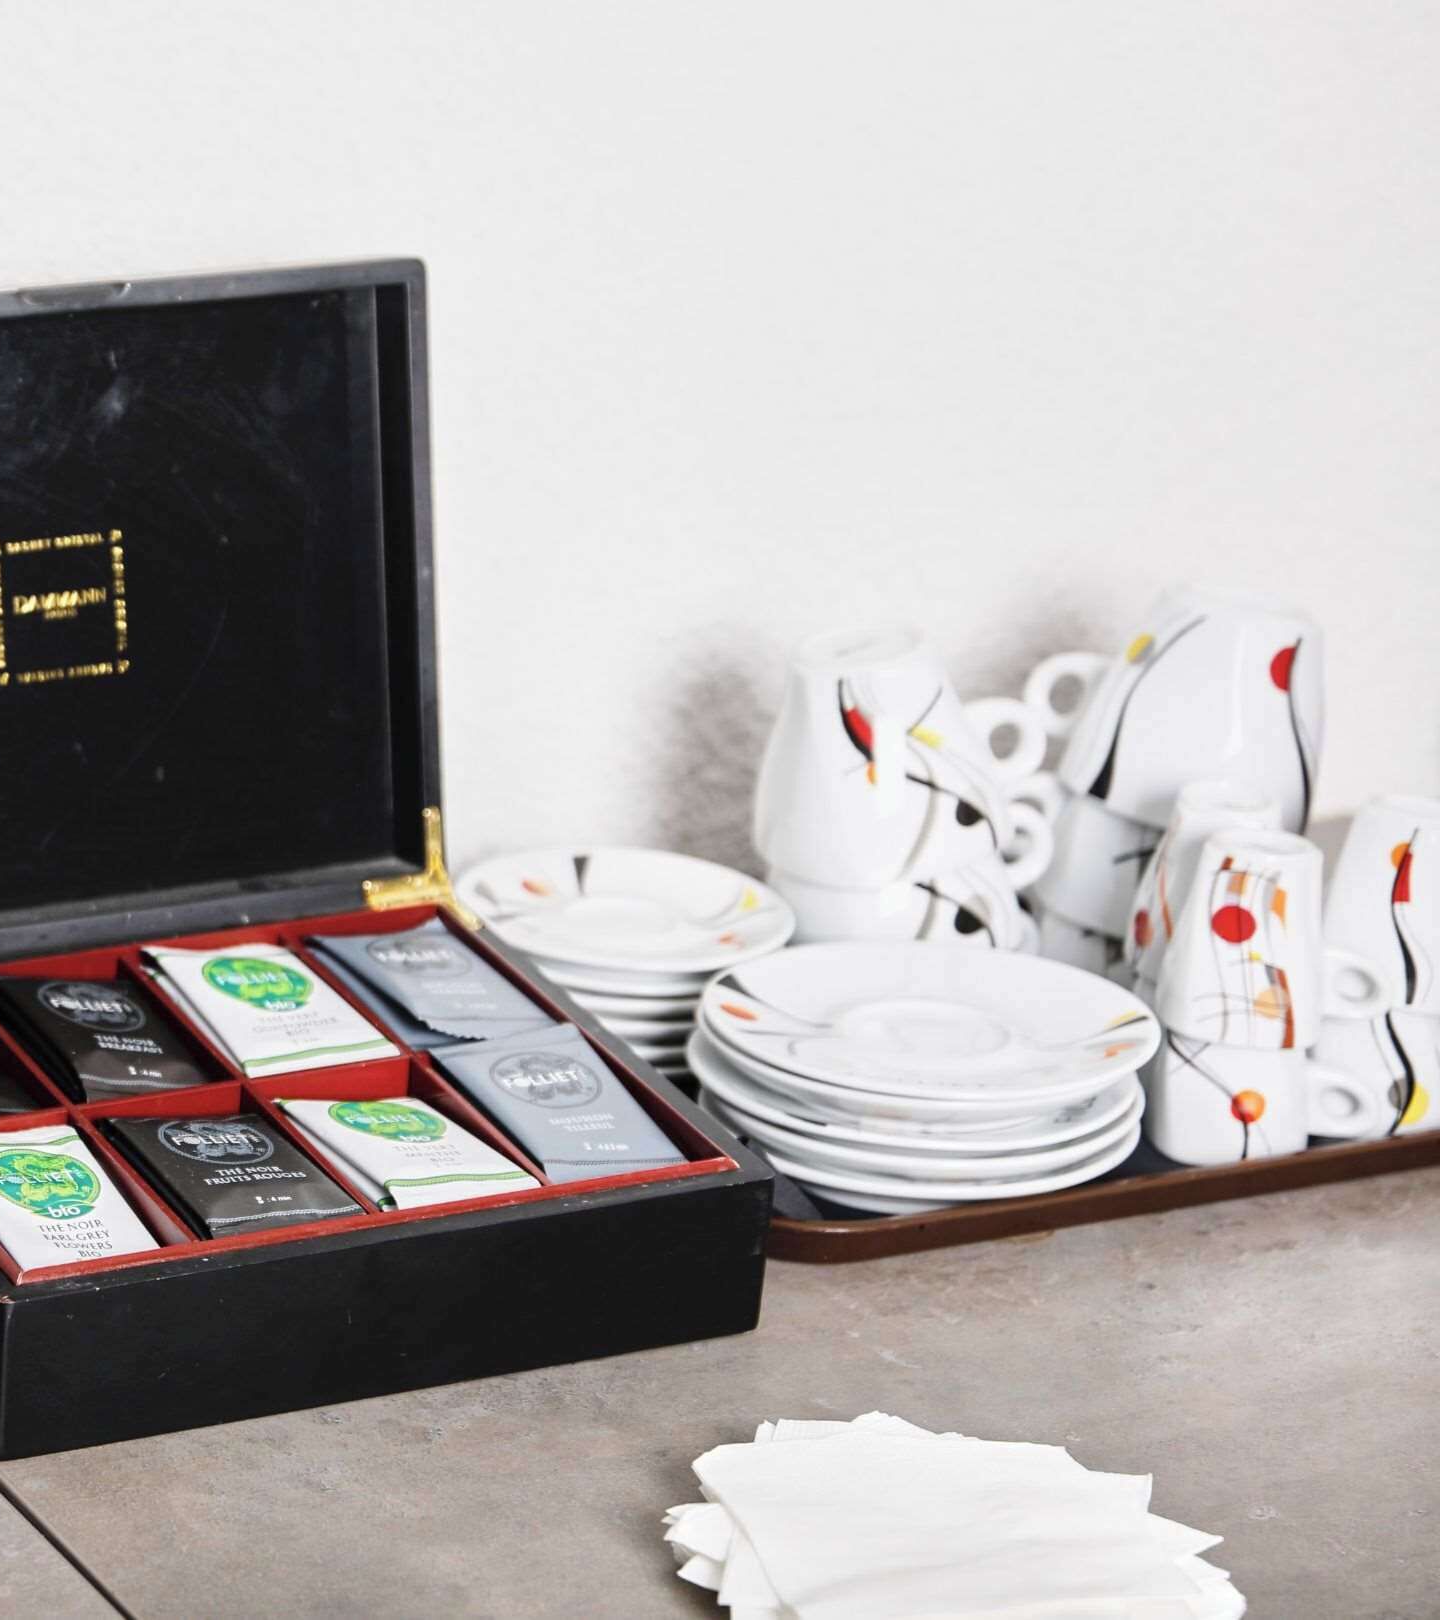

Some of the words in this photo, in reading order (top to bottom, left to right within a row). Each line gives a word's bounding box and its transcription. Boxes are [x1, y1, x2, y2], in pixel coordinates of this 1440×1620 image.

[503, 1070, 579, 1088] FOLLIET
[171, 1132, 253, 1147] FOLLIET
[245, 1165, 283, 1175] NOIR
[203, 1173, 252, 1186] FRUITS
[253, 1171, 307, 1182] ROUGES
[47, 1204, 81, 1218] bio
[66, 1218, 104, 1232] NOIR
[42, 1232, 74, 1242] EARL
[75, 1229, 112, 1242] GREY
[53, 1240, 113, 1250] FLOWERS
